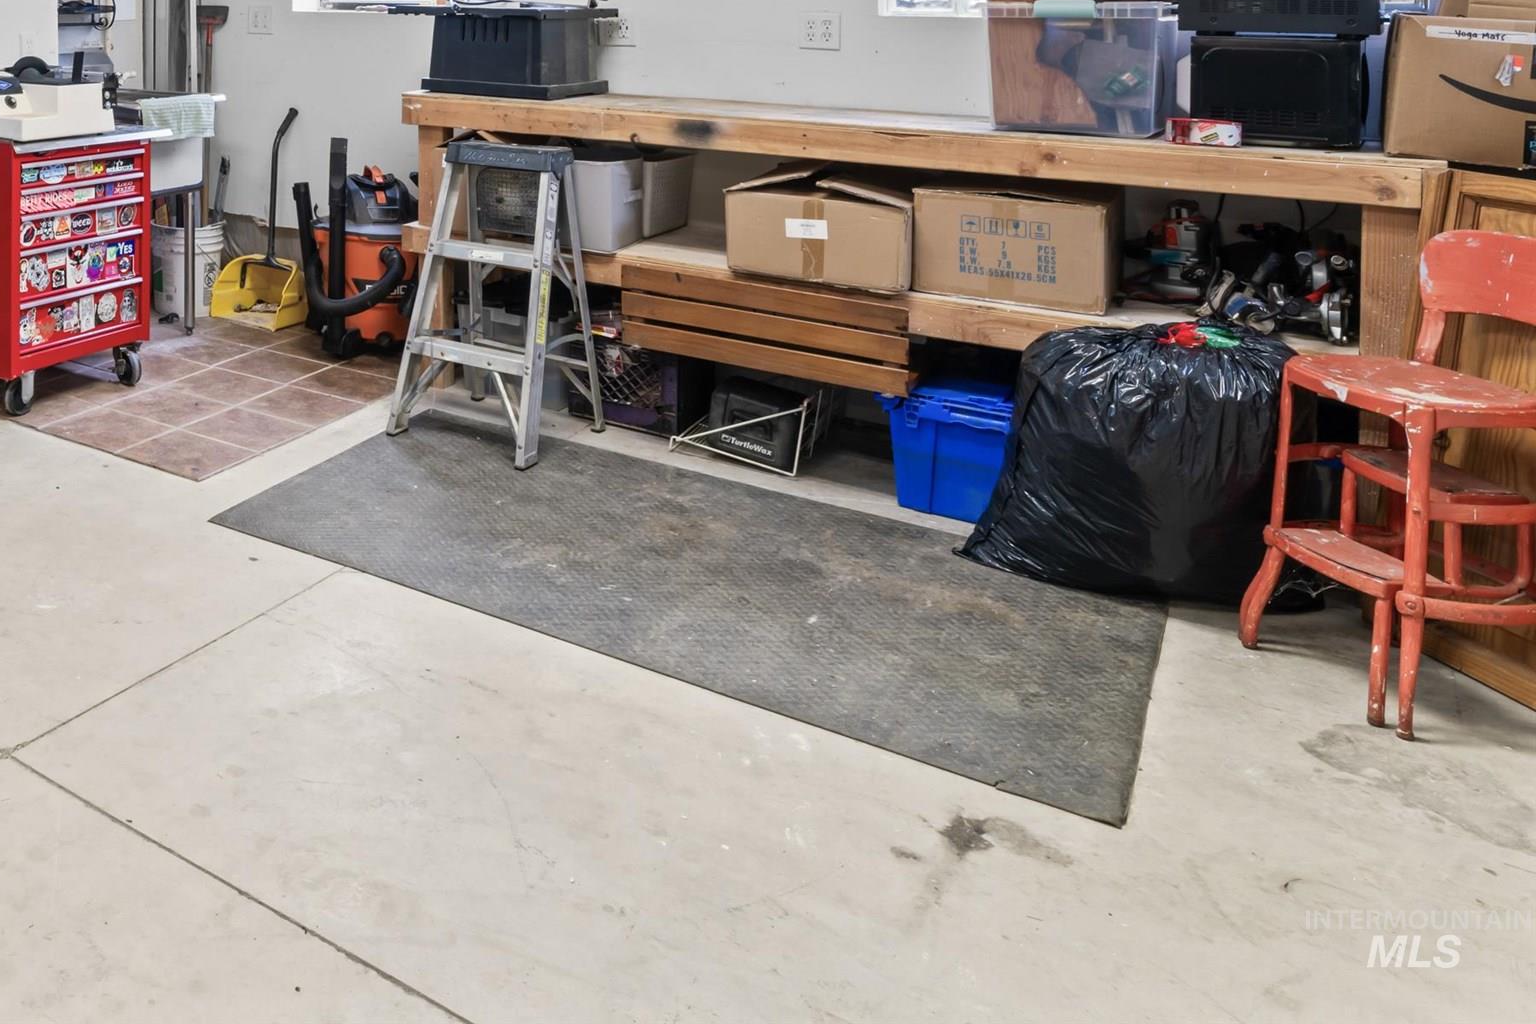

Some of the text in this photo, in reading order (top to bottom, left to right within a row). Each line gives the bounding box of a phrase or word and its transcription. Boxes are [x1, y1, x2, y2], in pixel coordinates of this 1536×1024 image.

[118, 242, 133, 254] YES
[1037, 245, 1057, 255] PCS
[1037, 255, 1057, 265] KGS
[1037, 264, 1057, 274] KGS
